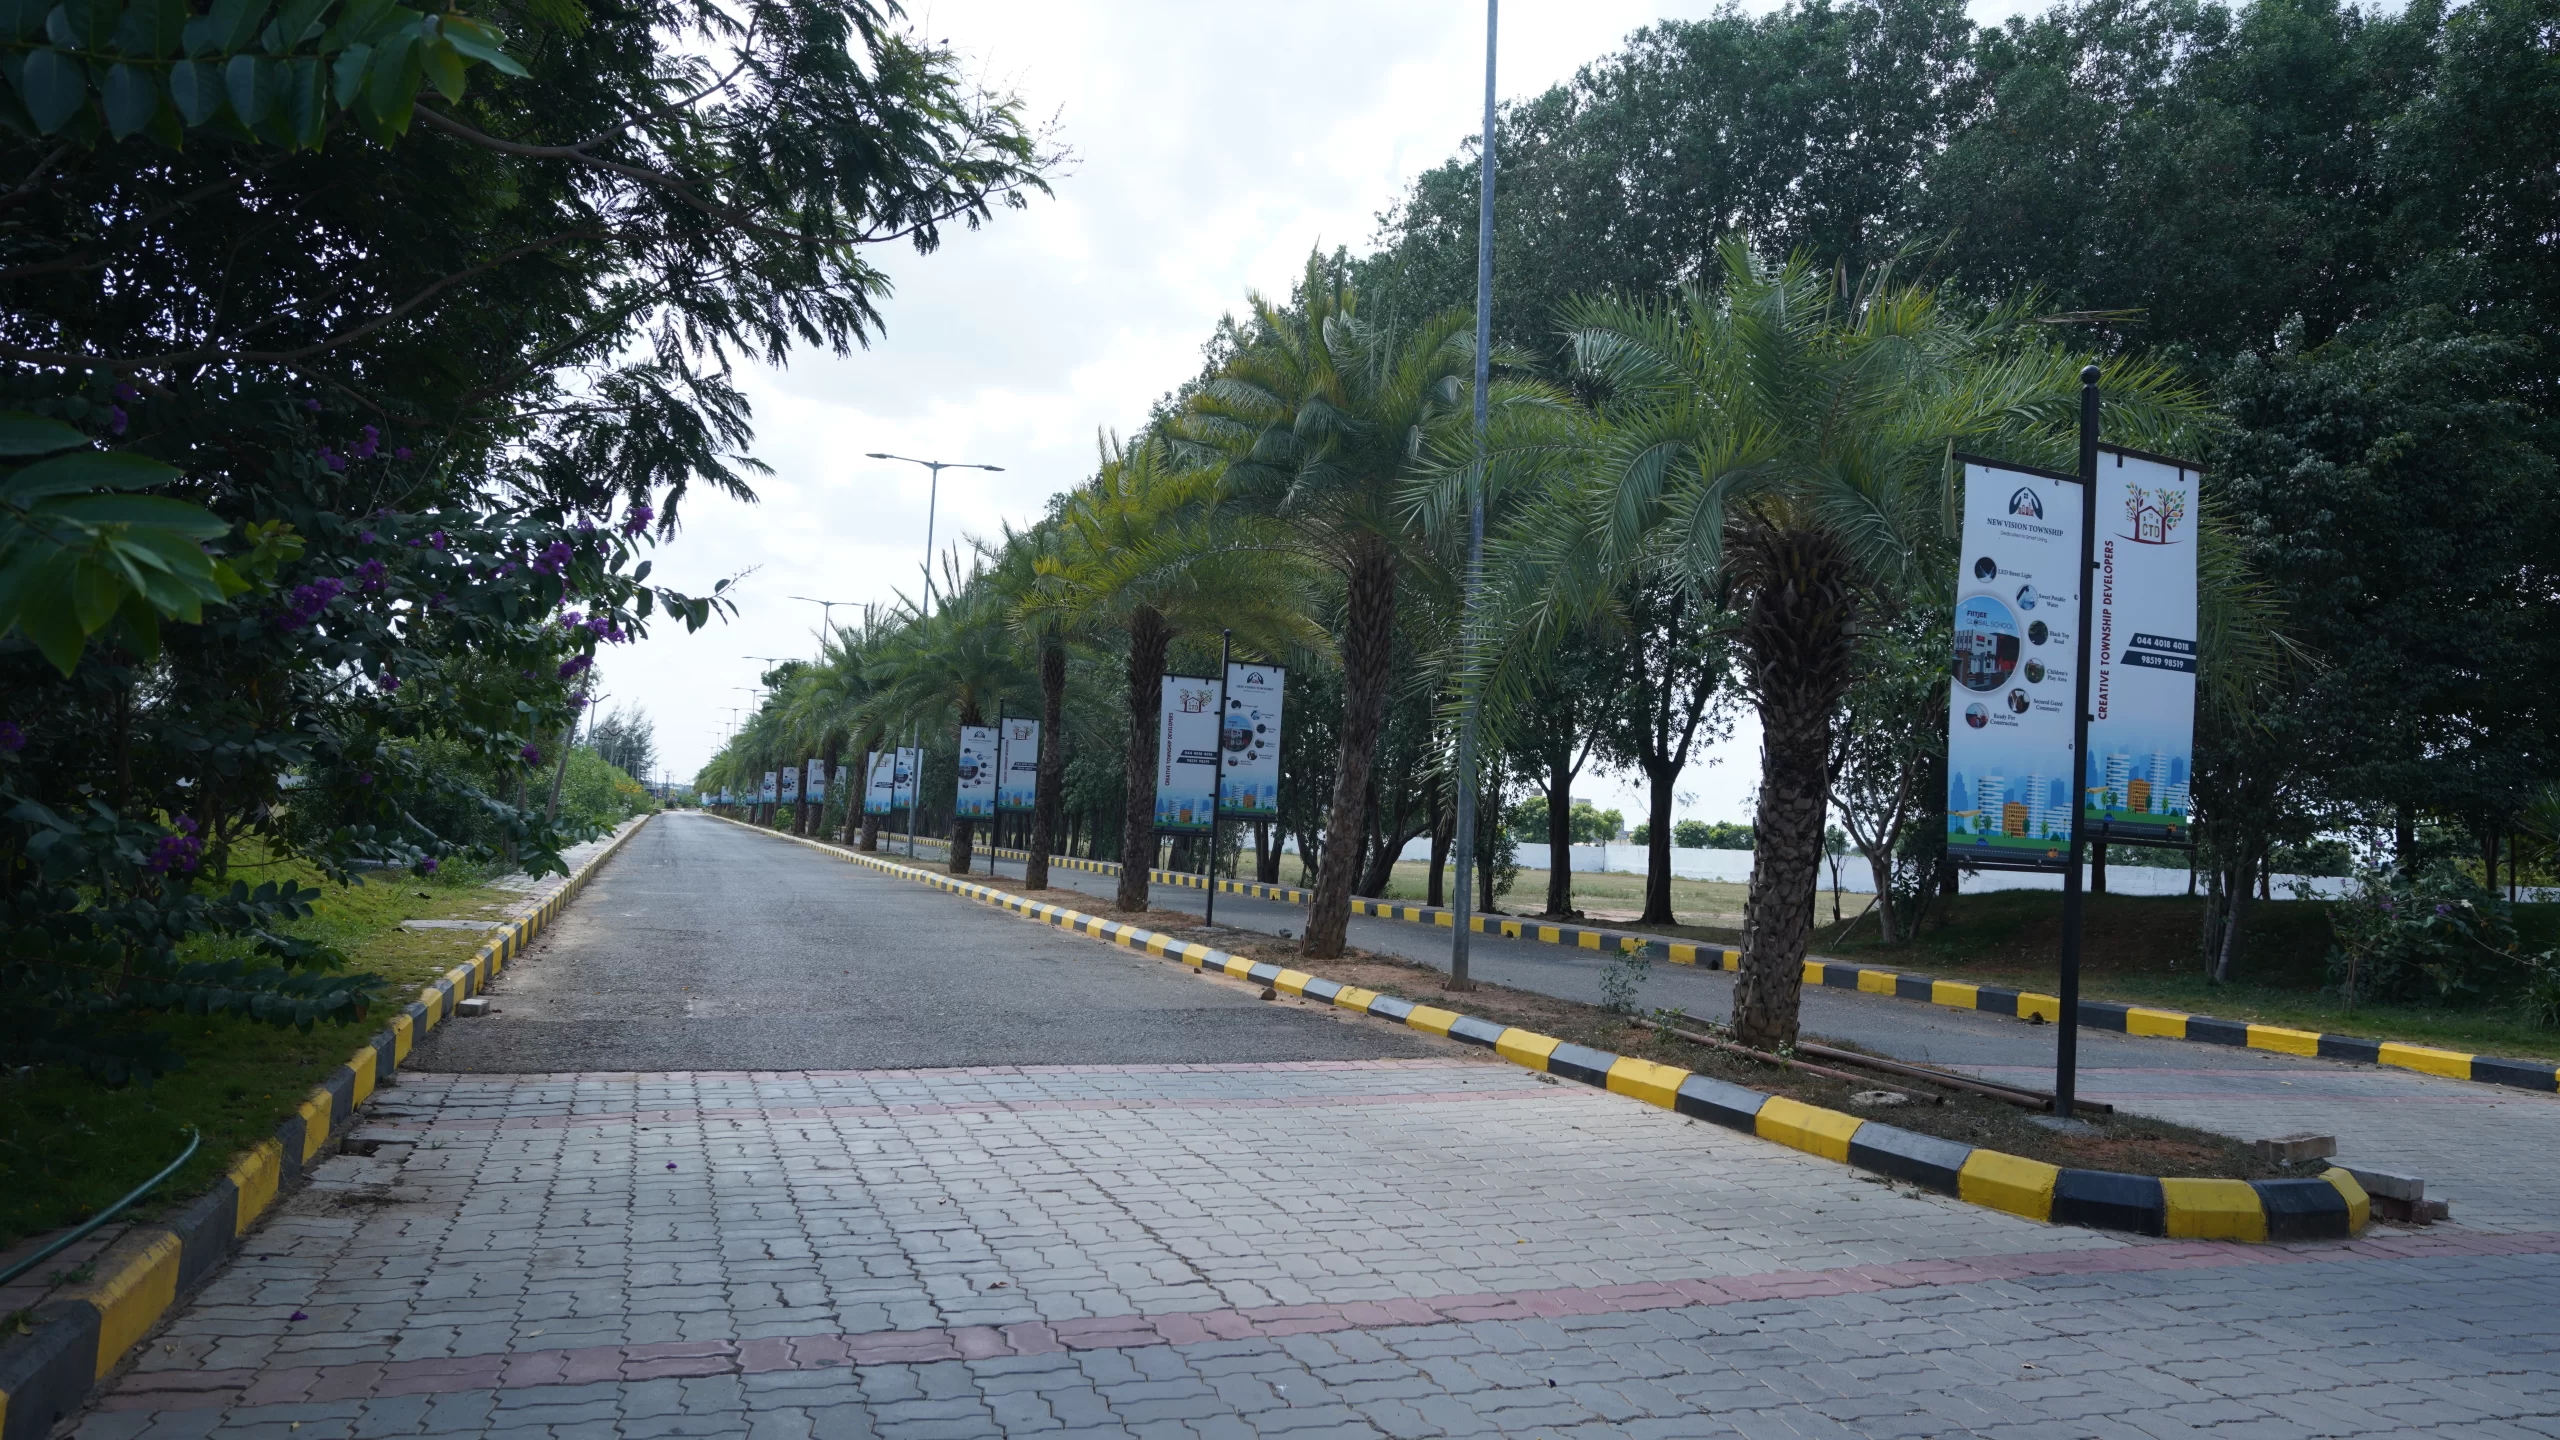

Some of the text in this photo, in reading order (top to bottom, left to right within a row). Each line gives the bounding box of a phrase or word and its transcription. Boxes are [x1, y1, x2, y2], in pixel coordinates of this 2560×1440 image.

[1987, 518, 2064, 537] NEW VISION TOWNSHIP
[2142, 523, 2160, 538] CTD
[1967, 610, 1988, 618] FIITJEE
[1966, 618, 2014, 630] GLOBAL SCHOOL
[2098, 540, 2114, 720] CREATIVE TOWNSHIP DEVELOPERS
[2136, 636, 2189, 651] 044 4018 4018
[2141, 655, 2184, 669] 98519 98519
[2035, 705, 2060, 713] Community
[1990, 719, 2019, 727] Construction
[1993, 713, 2007, 721] Ready
